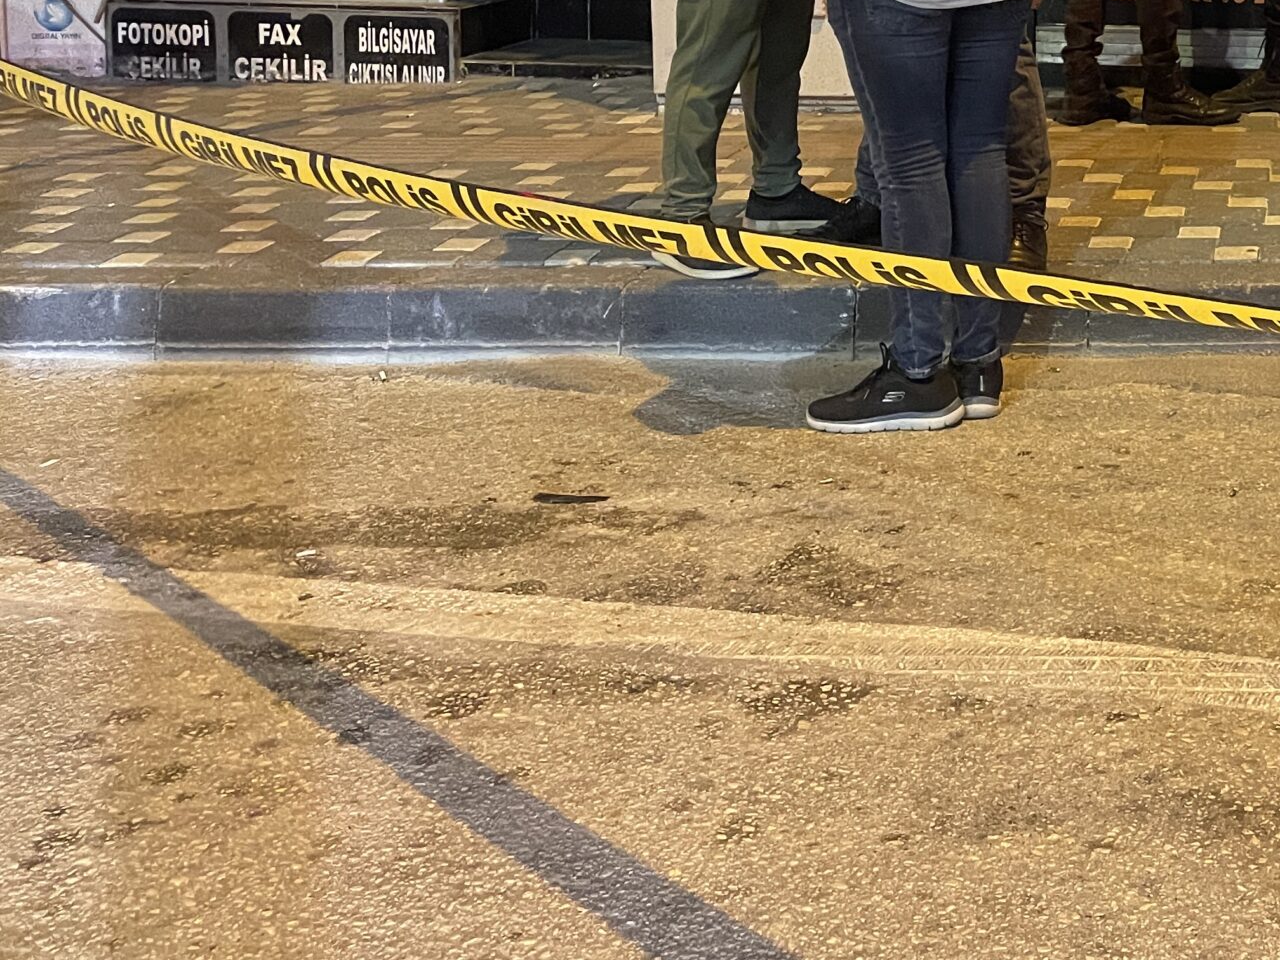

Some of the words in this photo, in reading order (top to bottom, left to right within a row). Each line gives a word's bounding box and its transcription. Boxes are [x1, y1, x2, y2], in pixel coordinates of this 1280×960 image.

[117, 19, 209, 47] FOTOKOPİ
[258, 22, 302, 46] FAX
[358, 20, 436, 55] BİLGİSAYAR
